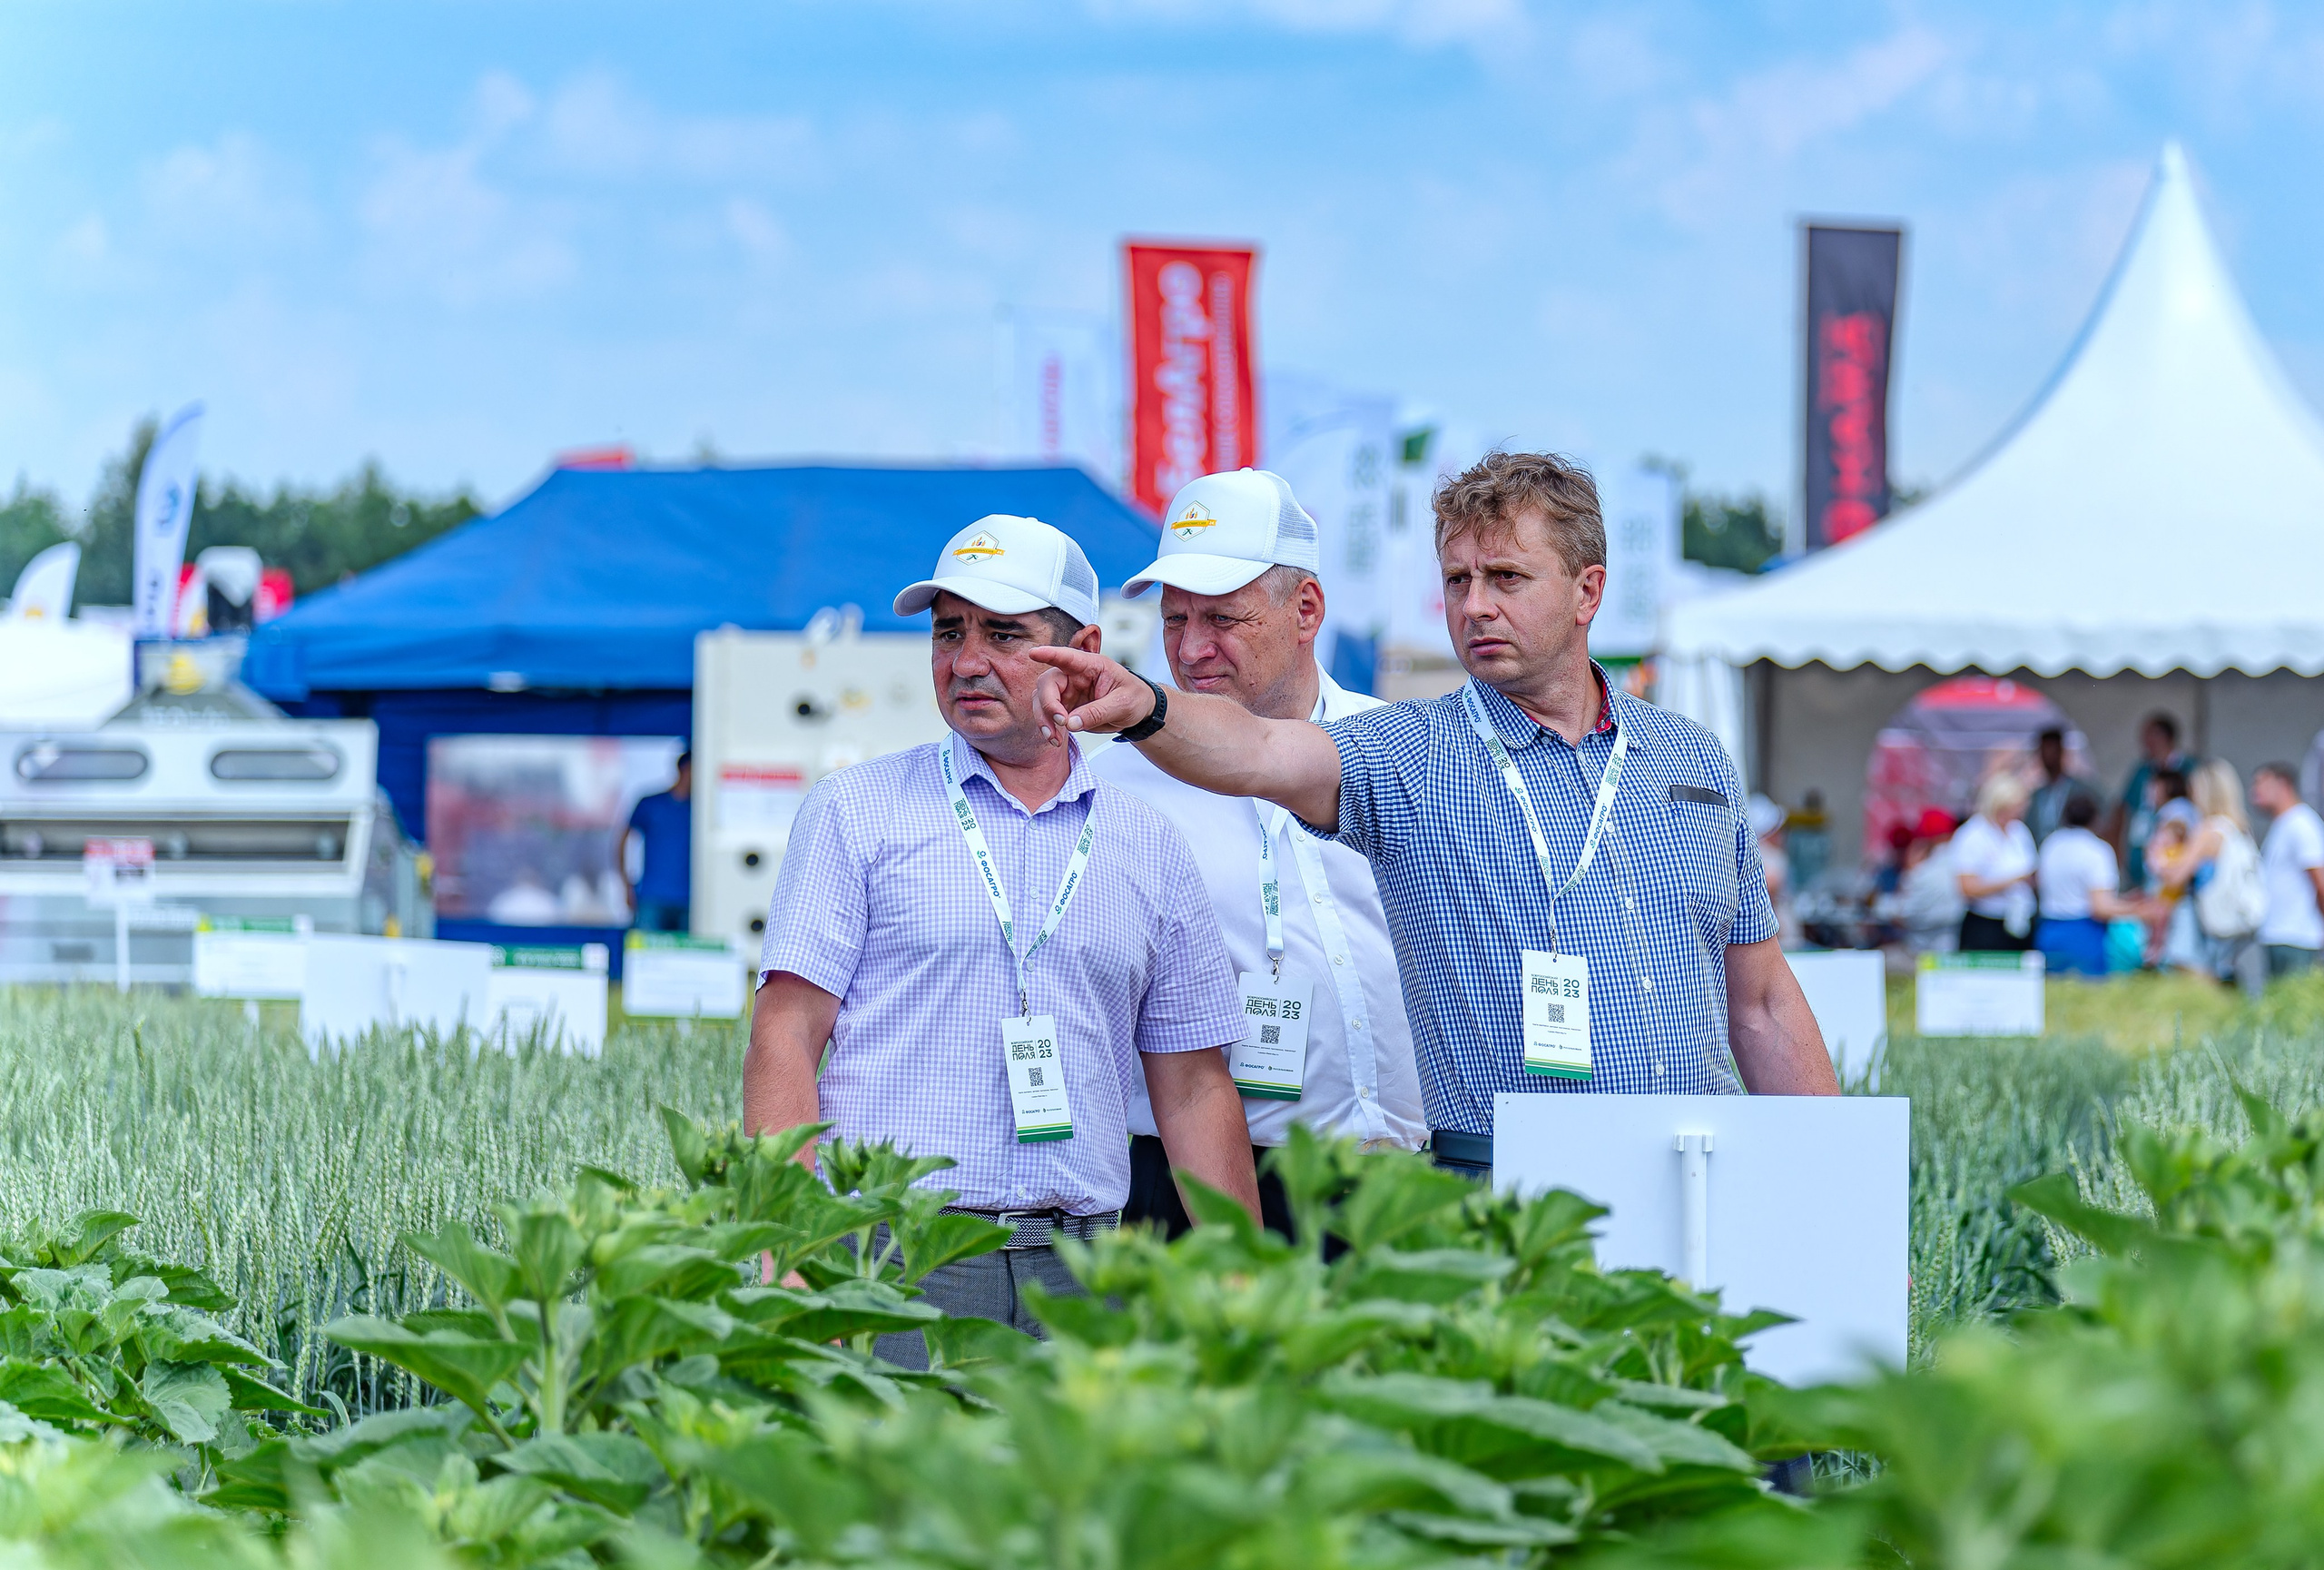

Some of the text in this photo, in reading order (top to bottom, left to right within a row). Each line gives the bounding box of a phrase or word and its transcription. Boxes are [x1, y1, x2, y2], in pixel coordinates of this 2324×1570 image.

[1467, 697, 1481, 723] ФОСАГРО
[1501, 757, 1511, 768] 20
[1612, 753, 1619, 765] 20
[1616, 756, 1623, 768] 23
[943, 756, 952, 784] ФОСАГРО
[1520, 795, 1537, 833] ФОСАГРО
[961, 820, 970, 832] 23
[967, 817, 977, 829] 20
[1593, 805, 1608, 840] ФОСАГРО
[980, 860, 1000, 897] ФОСАГРО
[1059, 872, 1078, 905] ФОСАГРО
[1531, 977, 1559, 987] ДЕНЬ
[1563, 978, 1580, 989] 20
[1531, 985, 1559, 996] ПОЛЯ
[1563, 988, 1580, 998] 23
[1246, 999, 1277, 1009] ДЕНЬ
[1283, 1000, 1302, 1010] 20
[1245, 1007, 1276, 1017] ПОЛЯ
[1282, 1010, 1300, 1020] 23
[1011, 1044, 1034, 1052] ДЕНЬ
[1037, 1039, 1051, 1048] 20
[1012, 1052, 1036, 1061] ПОЛЯ
[1039, 1049, 1052, 1058] 23
